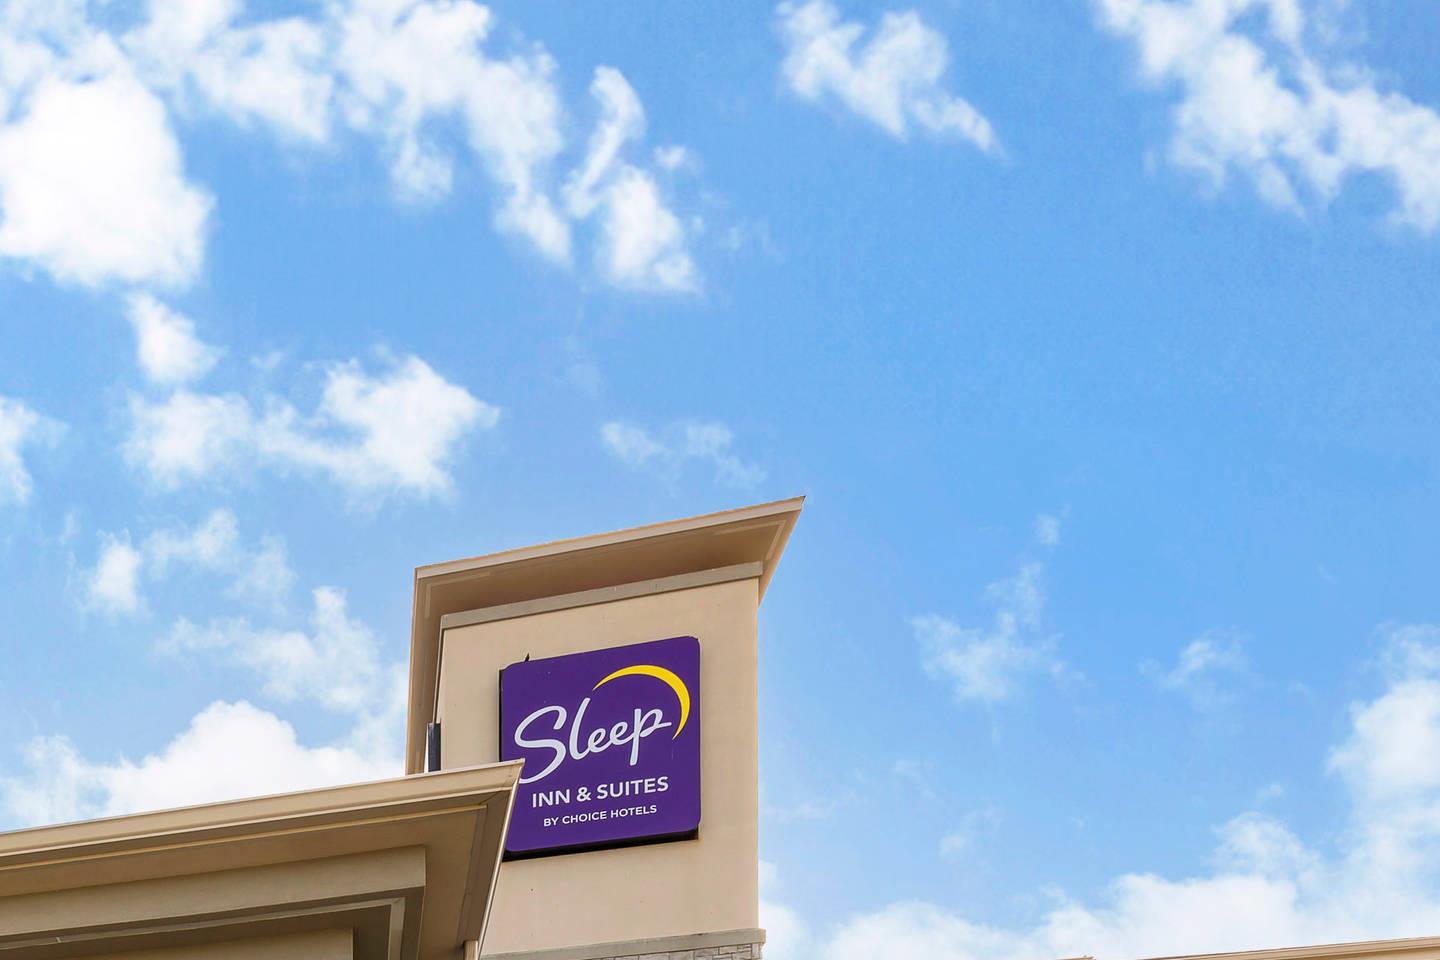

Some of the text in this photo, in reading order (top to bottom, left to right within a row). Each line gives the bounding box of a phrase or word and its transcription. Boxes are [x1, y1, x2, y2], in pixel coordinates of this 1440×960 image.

[514, 697, 672, 784] Sleep
[532, 776, 669, 808] INN & SUITES
[543, 804, 657, 827] BY CHOICE HOTELS
